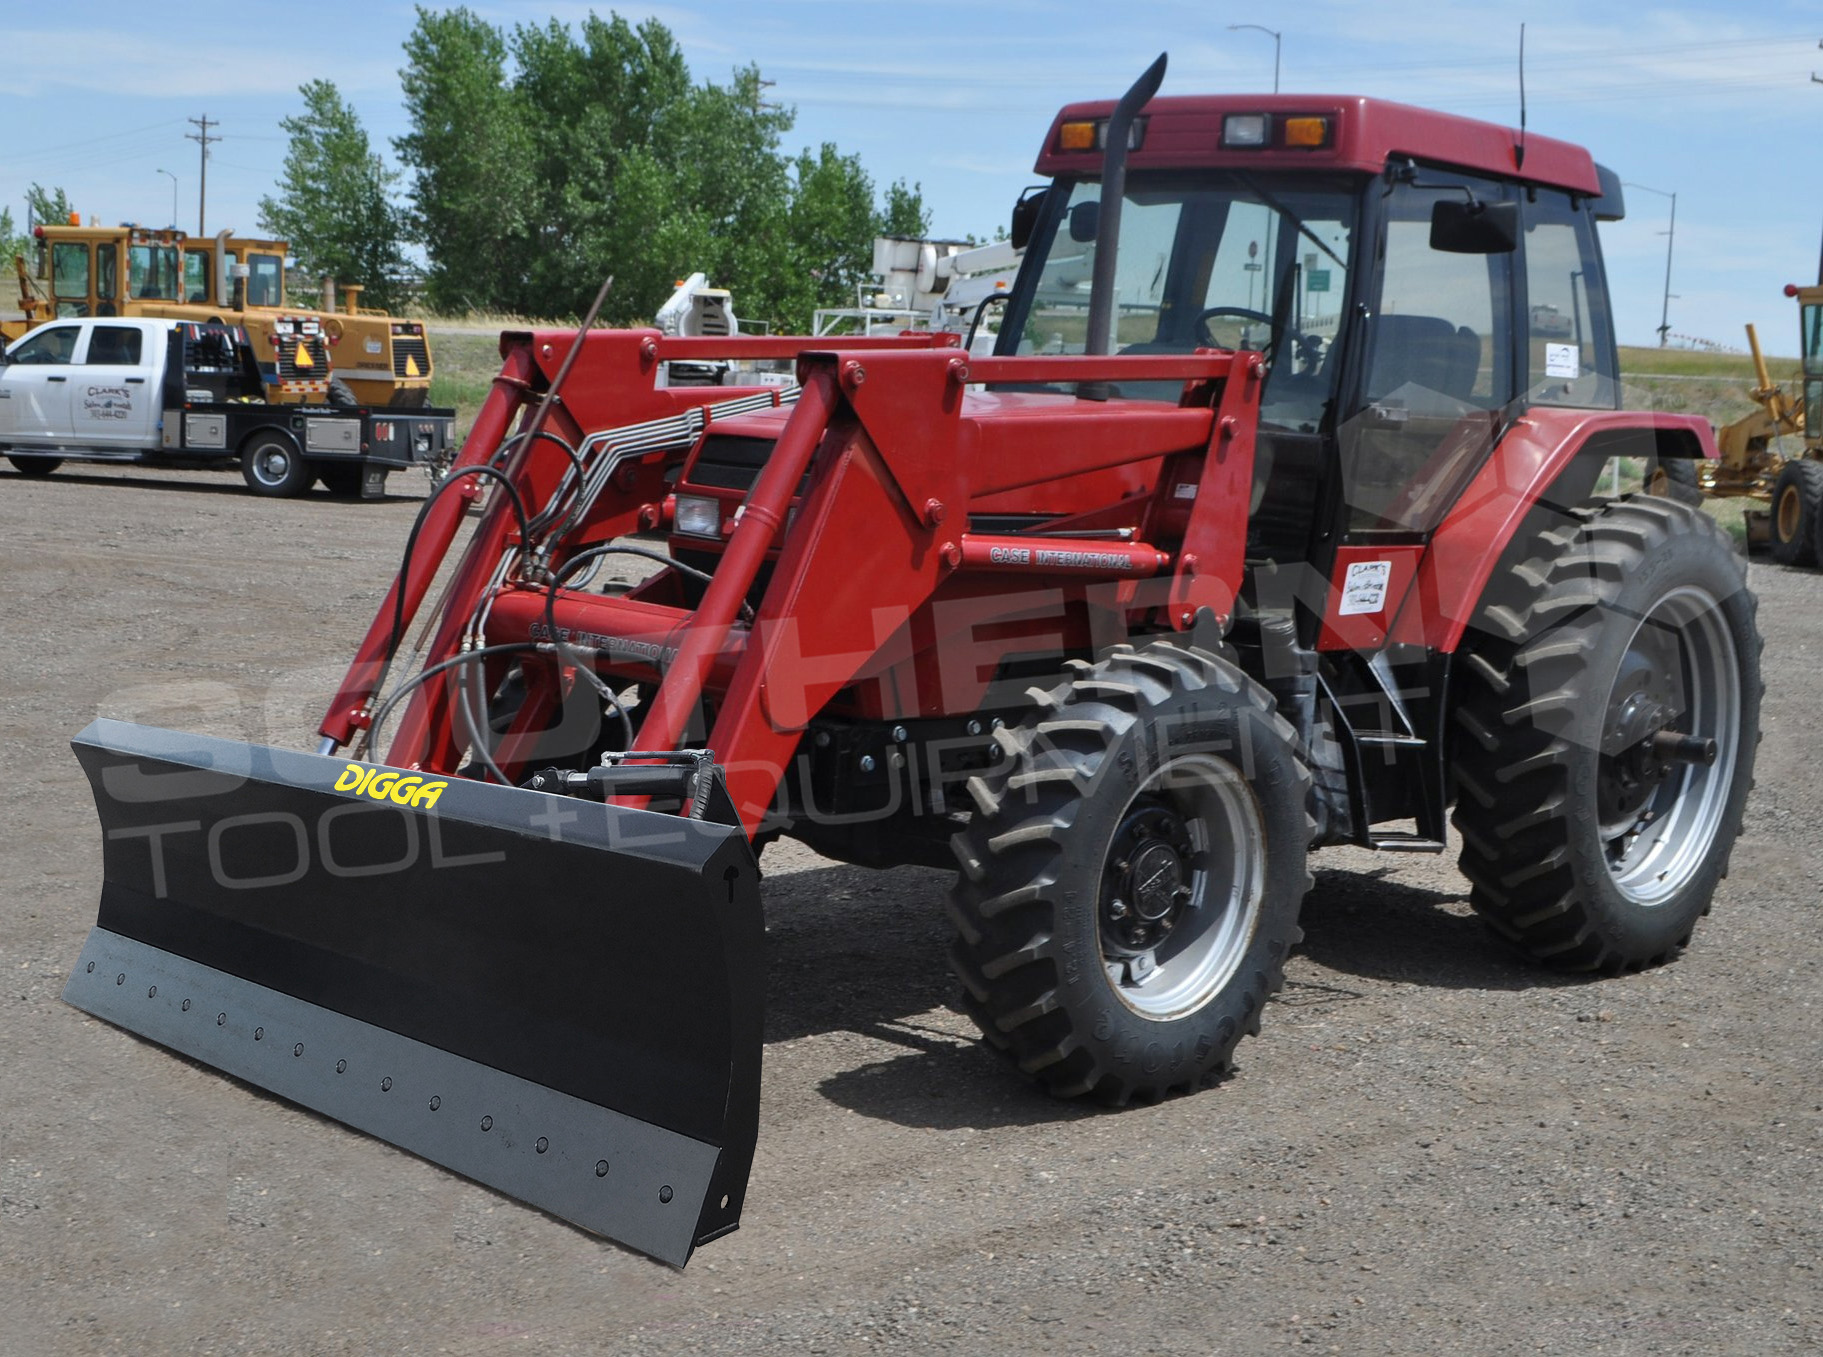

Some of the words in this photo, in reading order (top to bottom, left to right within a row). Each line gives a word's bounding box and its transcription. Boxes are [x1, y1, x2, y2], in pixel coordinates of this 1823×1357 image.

[88, 386, 131, 399] CLARK'S
[991, 547, 1031, 564] CASE
[1035, 550, 1133, 569] INTERNATIONAL
[334, 764, 449, 809] DIGGA
